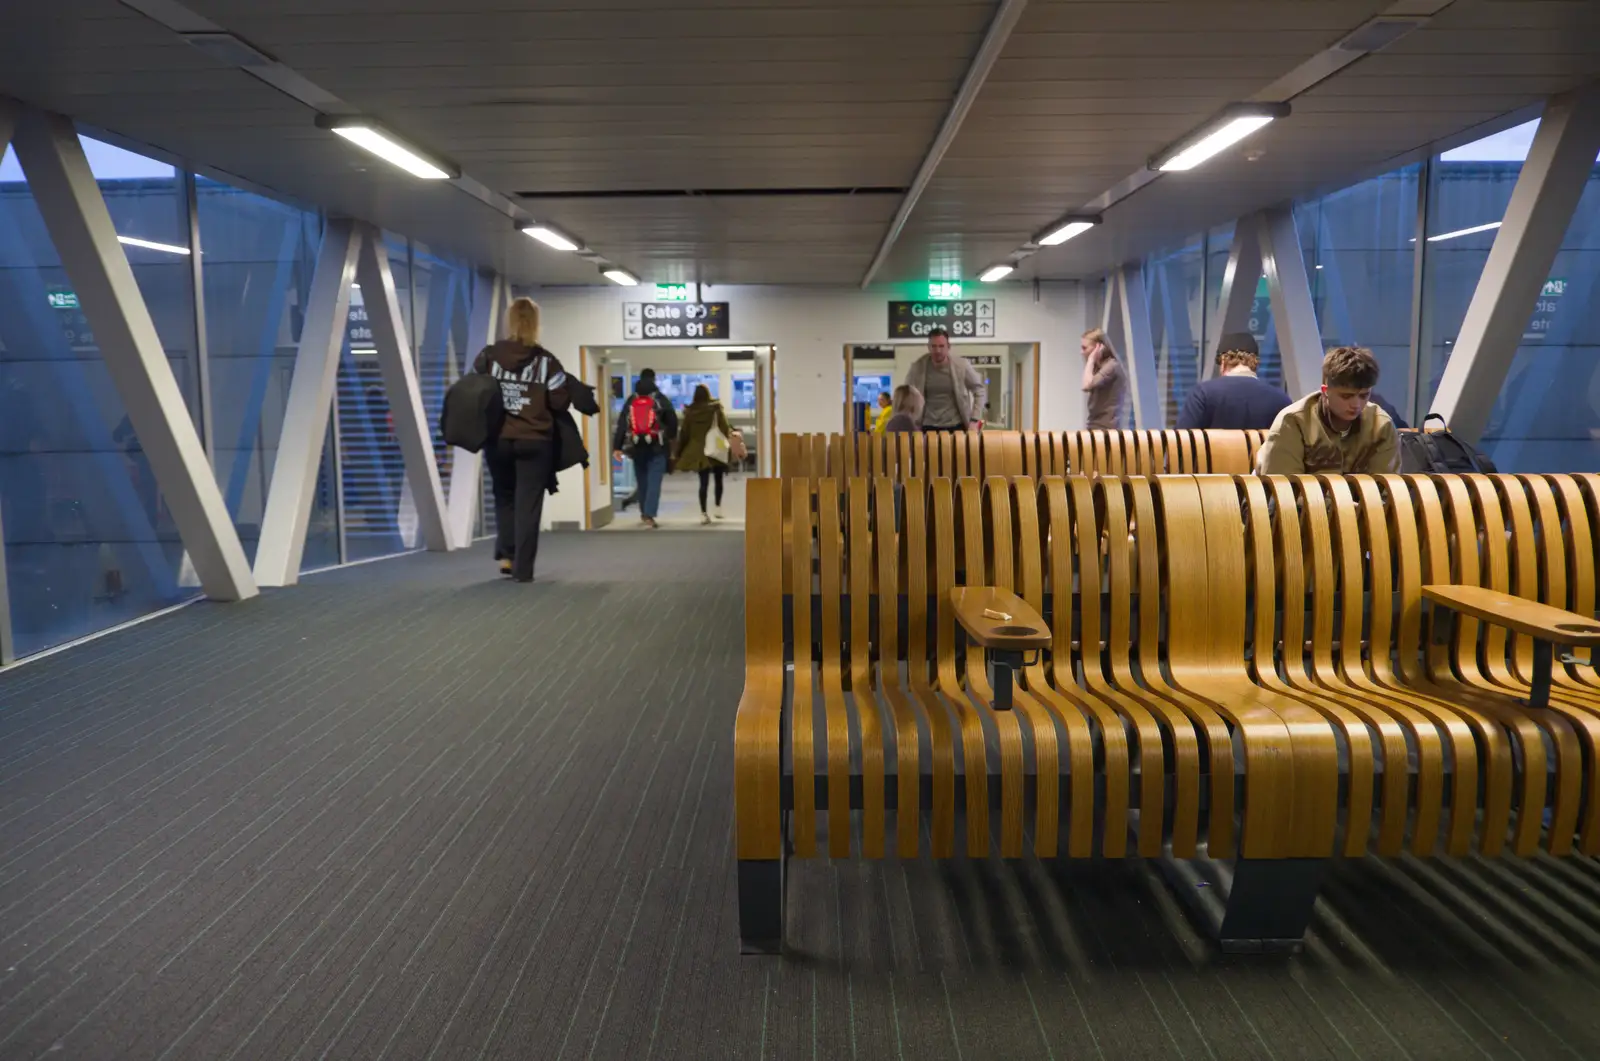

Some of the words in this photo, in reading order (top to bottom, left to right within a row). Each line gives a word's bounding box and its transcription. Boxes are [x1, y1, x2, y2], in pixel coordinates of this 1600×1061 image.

[644, 304, 681, 318] Gate
[912, 303, 947, 316] Gate
[953, 303, 973, 316] 92
[644, 322, 681, 337] Gate
[685, 322, 704, 337] 91
[953, 321, 973, 335] 93
